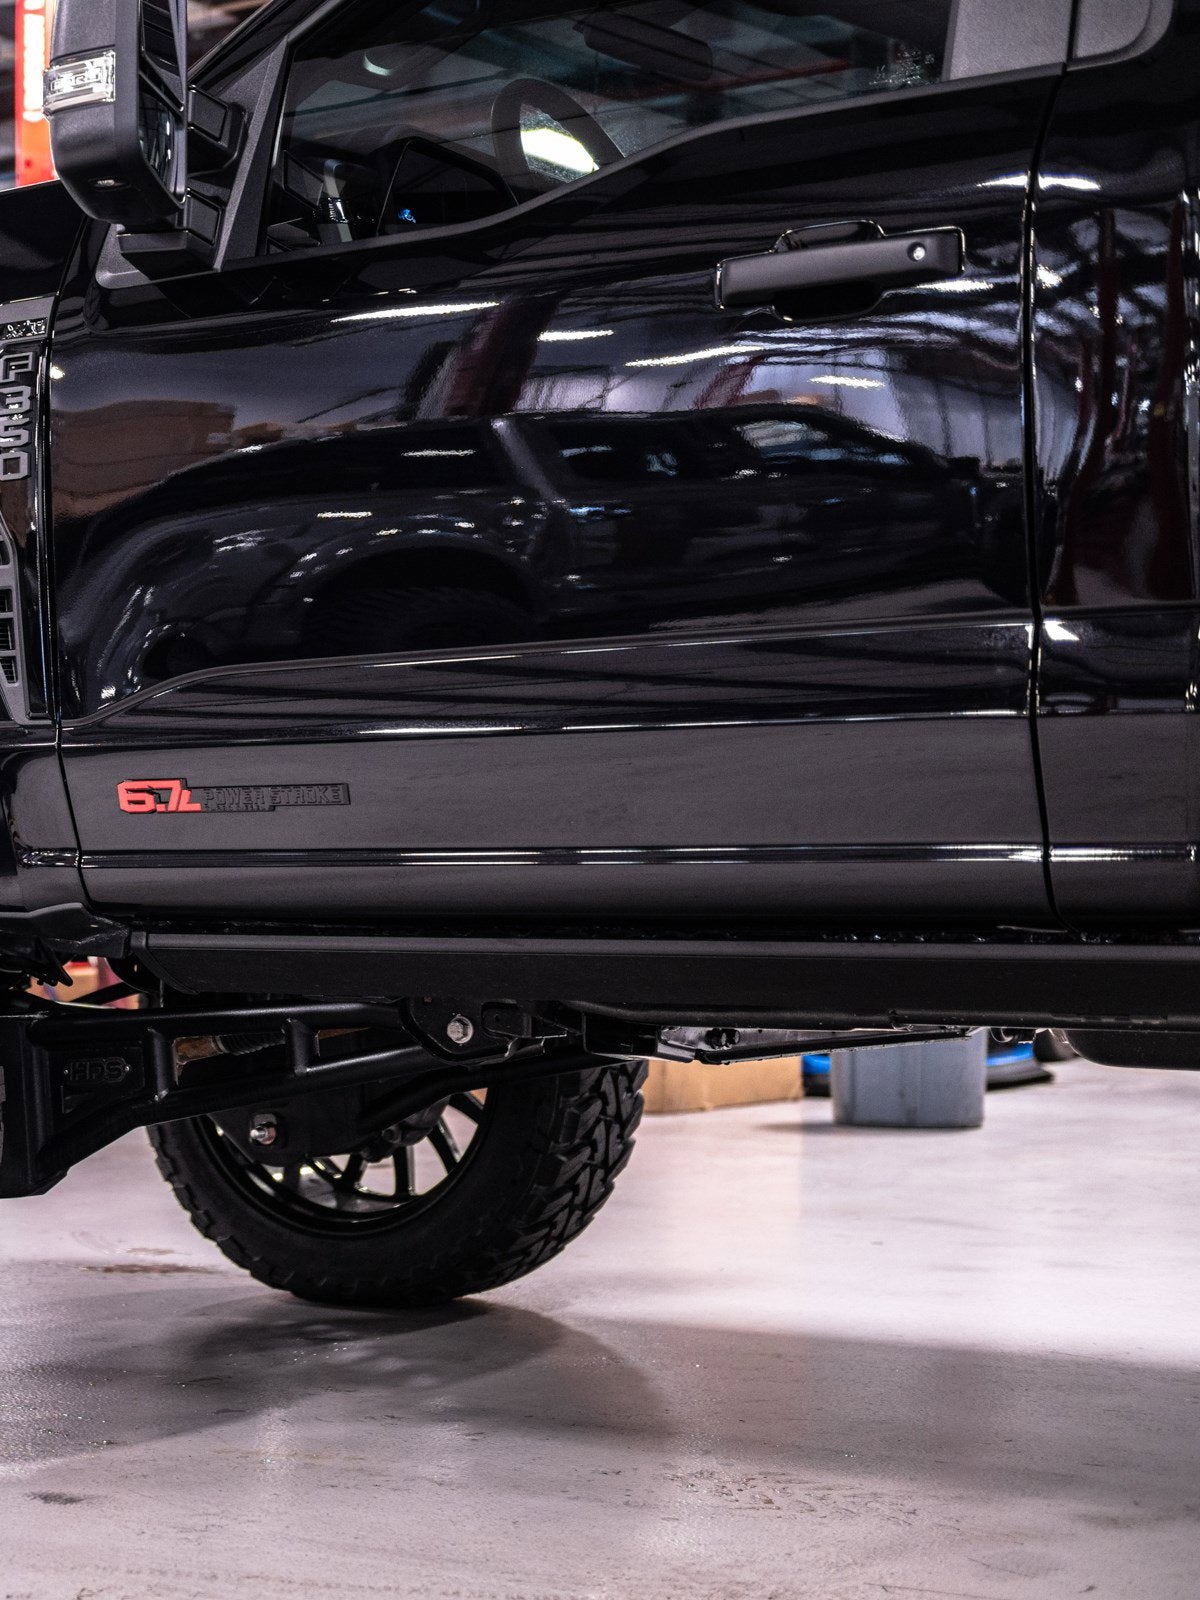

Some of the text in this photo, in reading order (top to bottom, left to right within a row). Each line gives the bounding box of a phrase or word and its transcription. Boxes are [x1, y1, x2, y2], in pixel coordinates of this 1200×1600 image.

[117, 779, 202, 814] 6.7L
[202, 787, 268, 806] POWER
[270, 784, 344, 805] STROKE
